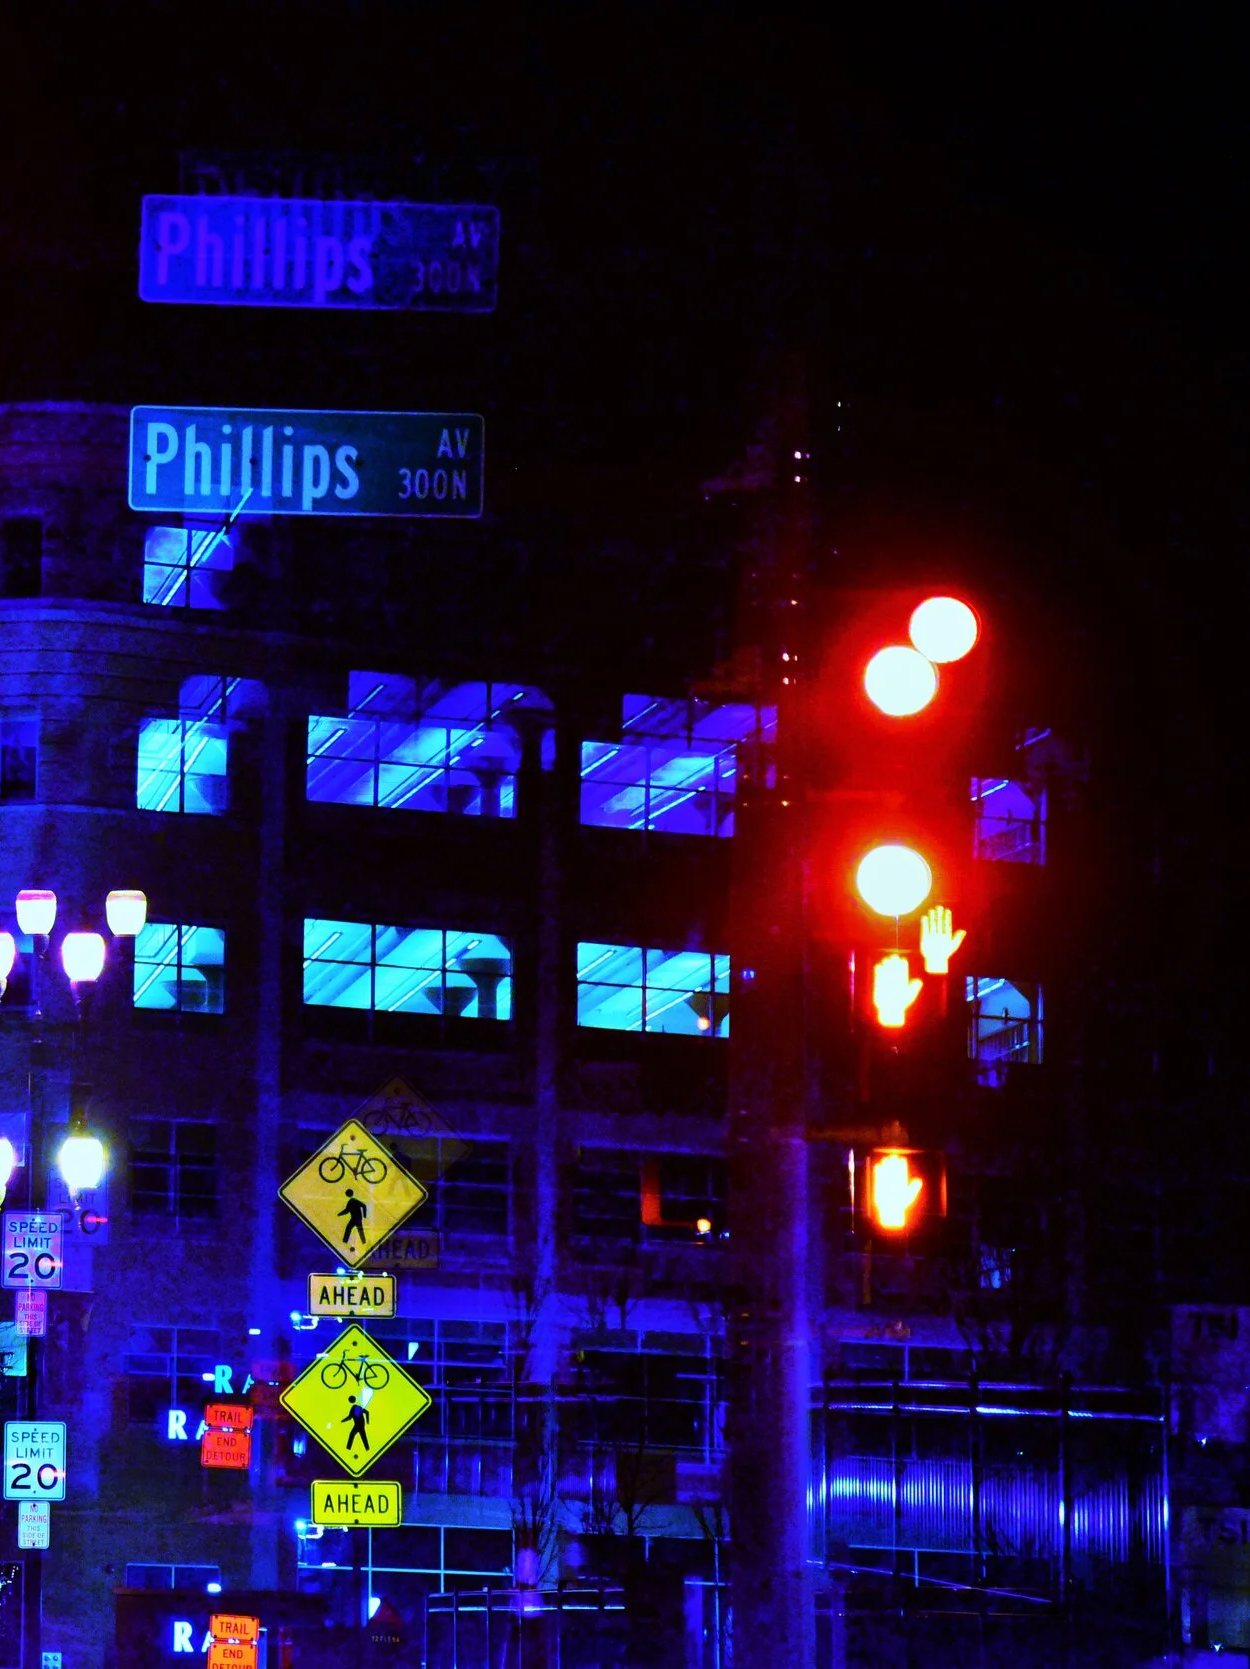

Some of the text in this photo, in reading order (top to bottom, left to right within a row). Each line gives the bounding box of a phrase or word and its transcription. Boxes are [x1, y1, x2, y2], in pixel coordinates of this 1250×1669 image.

[156, 212, 482, 302] Phillips AV
[145, 422, 471, 511] Phillips AV
[398, 468, 467, 500] 300N
[9, 1221, 58, 1233] SPEED
[14, 1237, 52, 1249] LIMIT
[370, 1240, 430, 1260] HEAD
[8, 1253, 57, 1280] 20
[319, 1286, 385, 1306] AHEAD
[214, 1410, 243, 1424] TRAIL
[11, 1432, 60, 1443] SPEED
[216, 1438, 237, 1447] END
[16, 1448, 54, 1458] LIMIT
[206, 1451, 246, 1461] DETOUR
[11, 1463, 58, 1490] 20
[323, 1494, 390, 1514] AHEAD
[21, 1514, 47, 1523] PARKING
[220, 1621, 250, 1635] TRAIL
[222, 1649, 243, 1659] END
